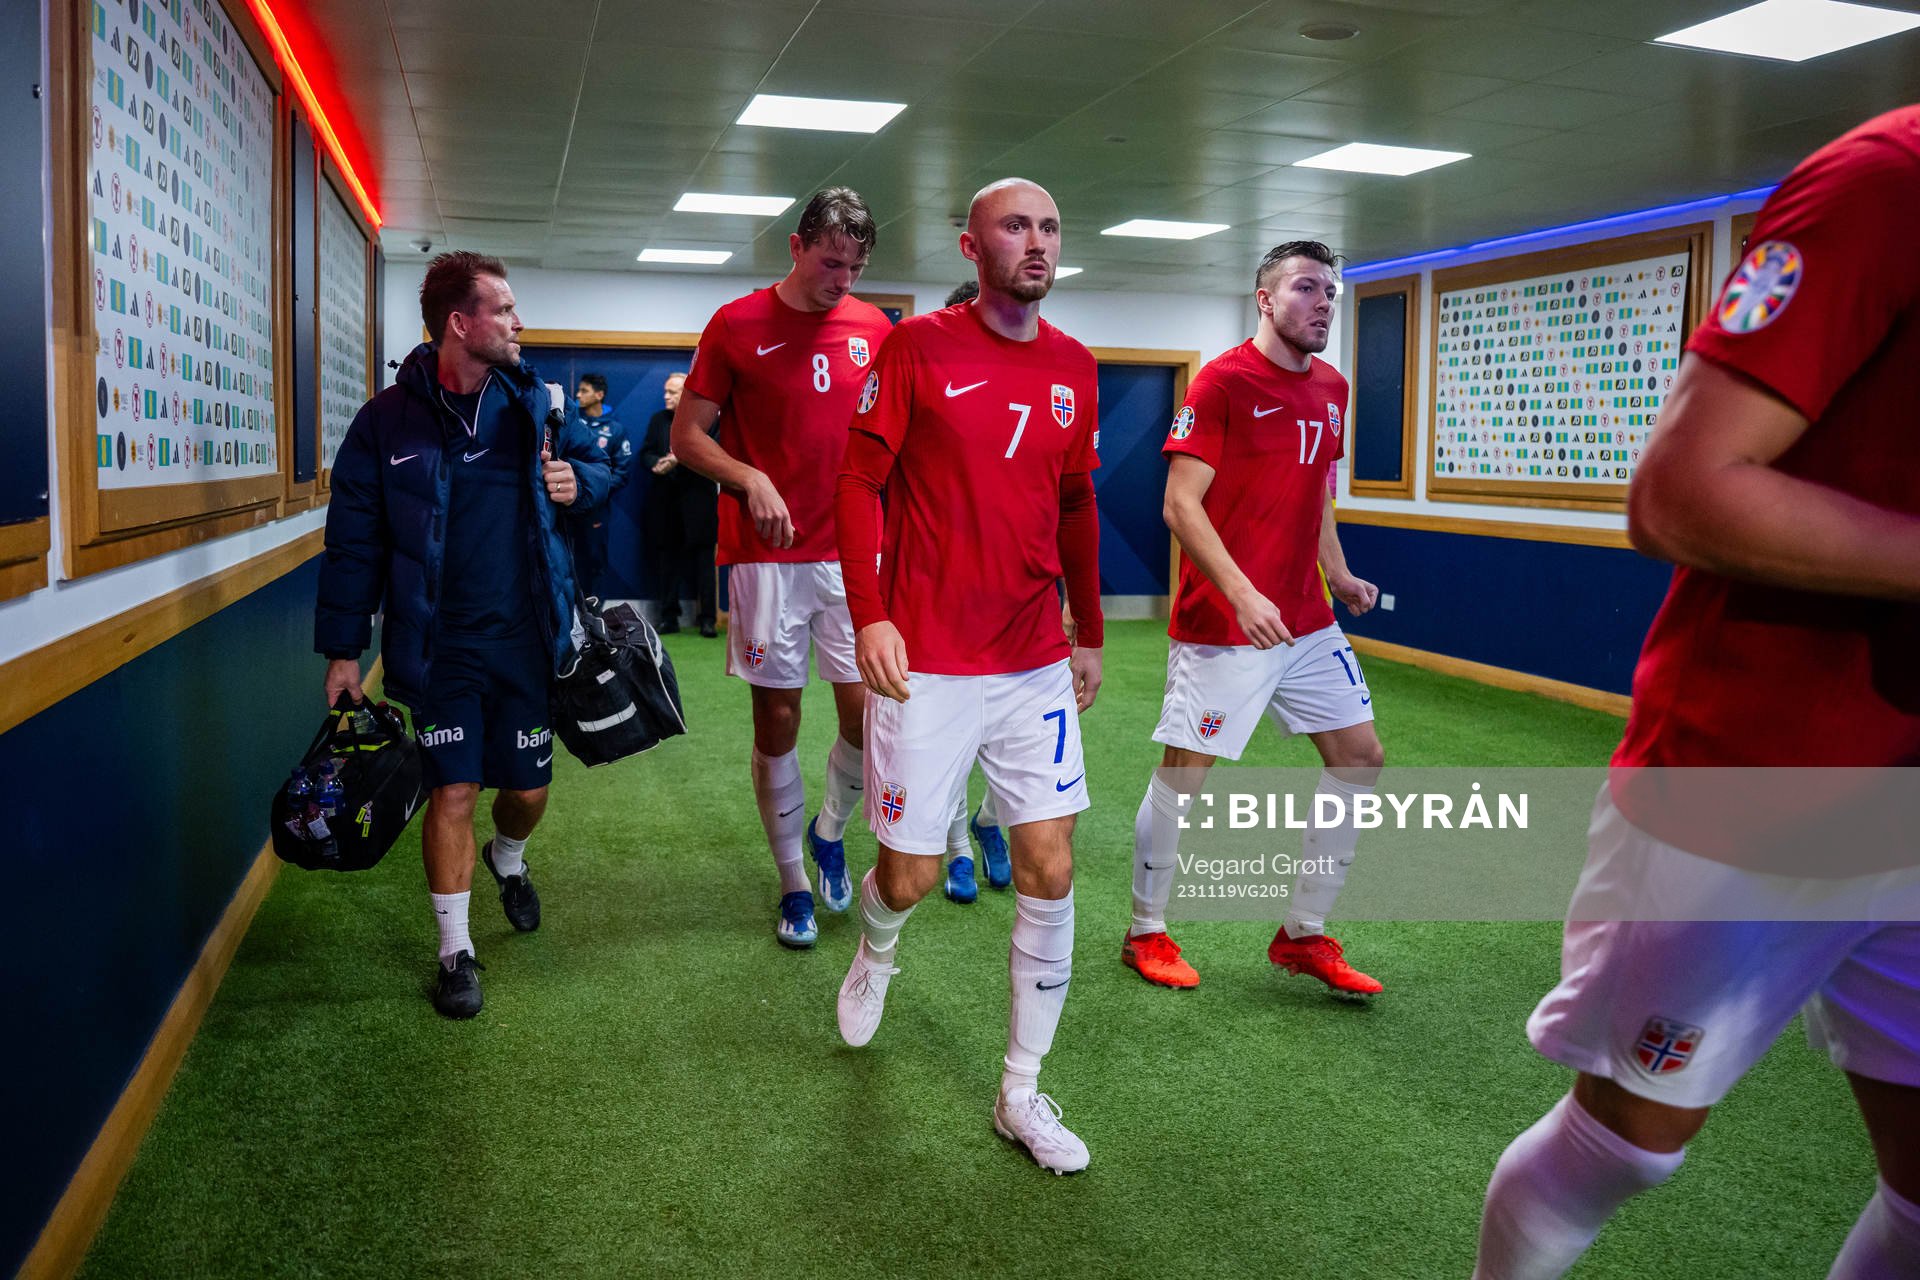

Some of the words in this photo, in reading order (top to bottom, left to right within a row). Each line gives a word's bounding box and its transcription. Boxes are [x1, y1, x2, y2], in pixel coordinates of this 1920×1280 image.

[812, 354, 831, 392] 8
[1004, 403, 1032, 458] 7
[1296, 419, 1323, 464] 17
[517, 728, 552, 749] bam
[1043, 708, 1066, 764] 7
